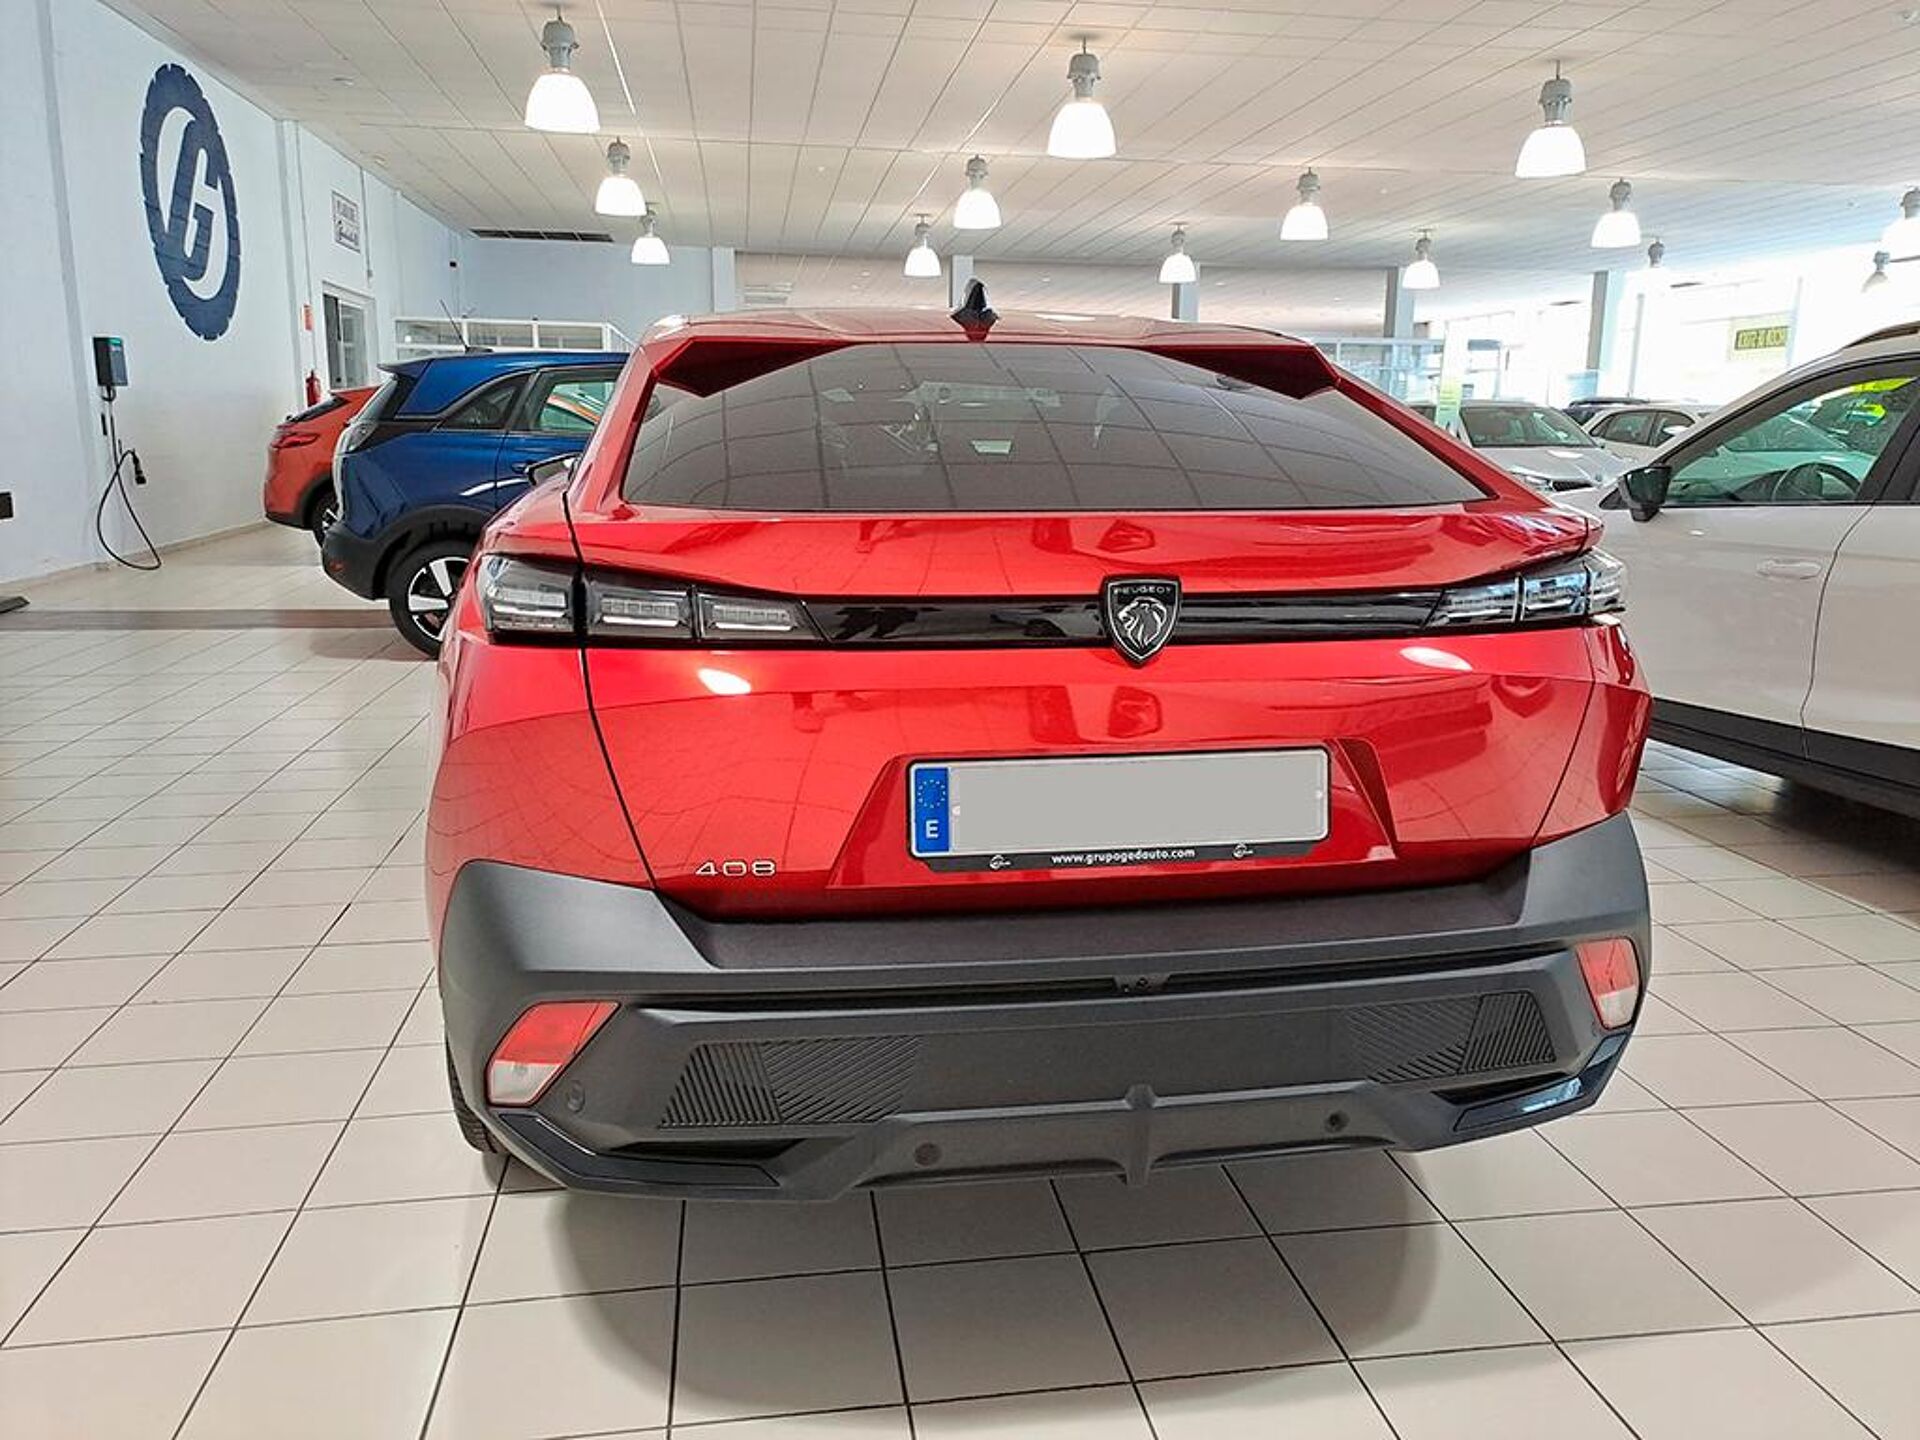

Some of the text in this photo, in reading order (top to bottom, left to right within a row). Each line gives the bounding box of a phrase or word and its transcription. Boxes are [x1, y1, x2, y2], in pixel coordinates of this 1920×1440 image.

[1113, 585, 1171, 595] PEUGEOT
[925, 819, 940, 839] E
[1051, 848, 1196, 865] www.grupogedauto.com
[695, 861, 776, 877] 408
